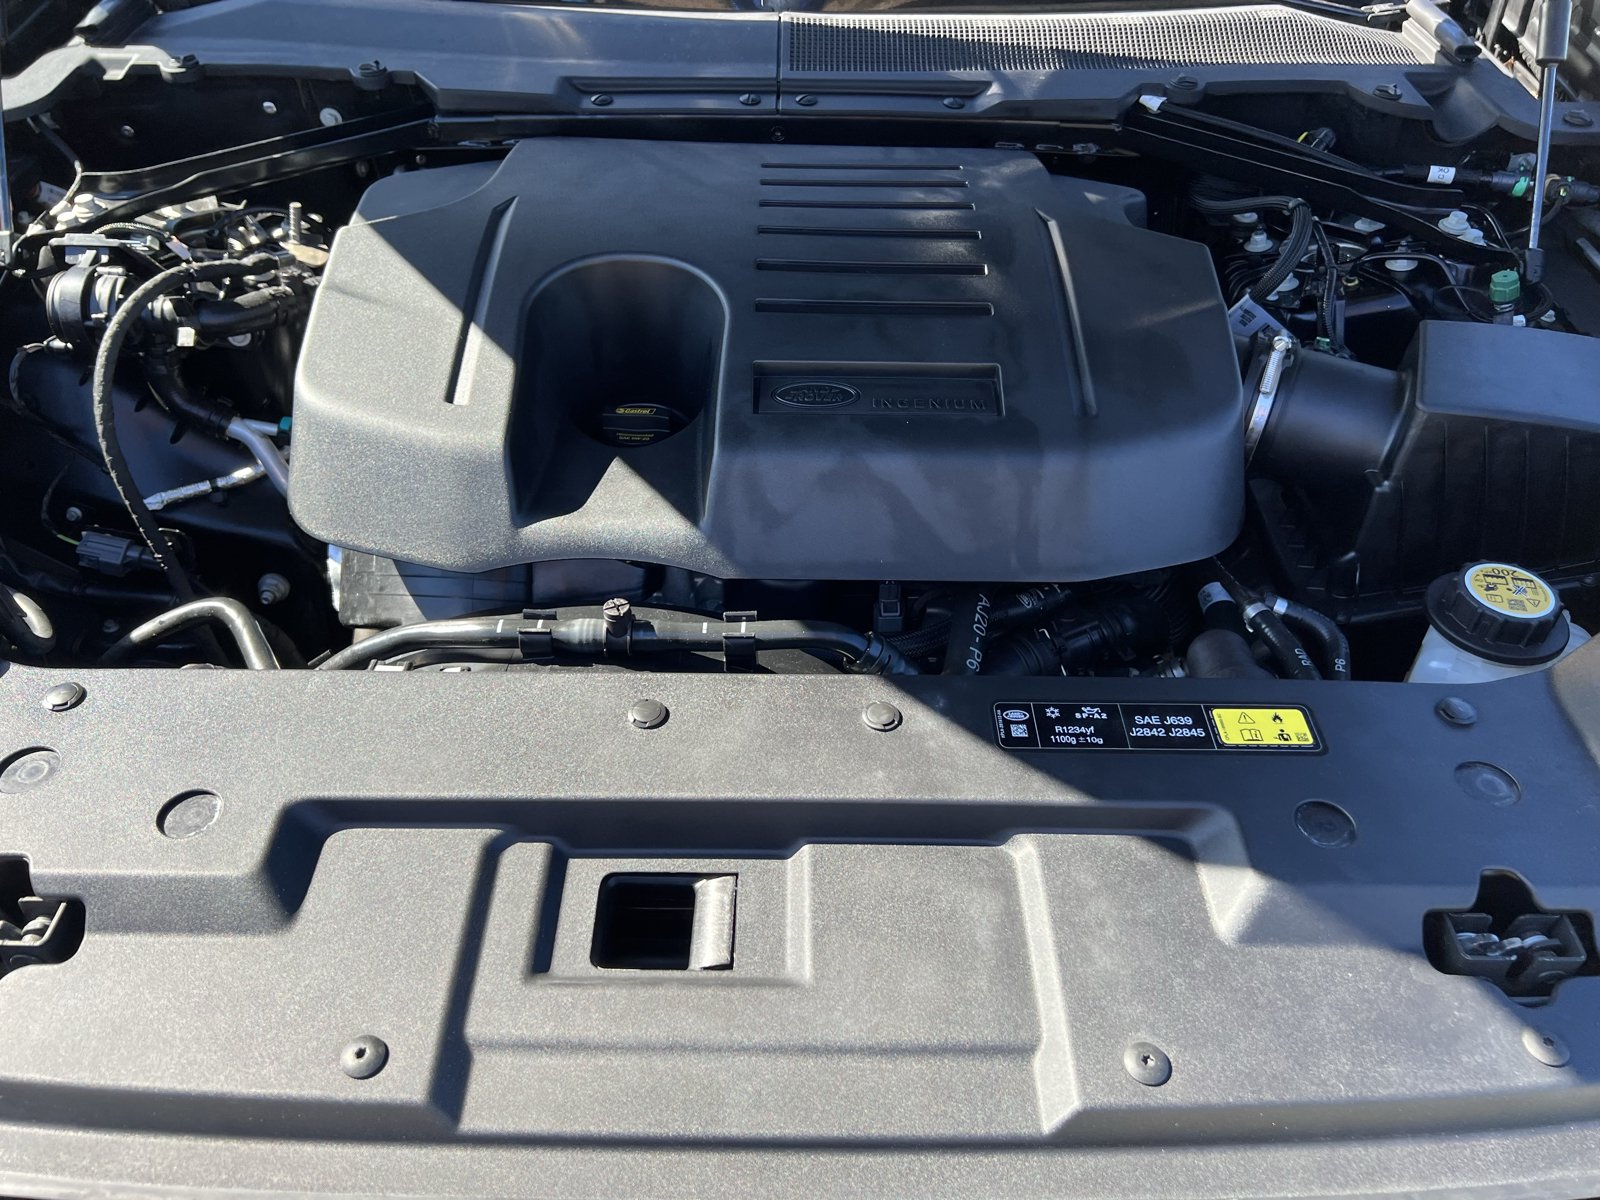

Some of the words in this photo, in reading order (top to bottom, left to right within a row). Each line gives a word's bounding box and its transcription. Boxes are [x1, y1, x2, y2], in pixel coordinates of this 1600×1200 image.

[872, 397, 986, 410] INGENIUM
[1334, 658, 1346, 672] P6
[1134, 716, 1162, 725] SAE
[1163, 716, 1193, 725] J639
[1055, 725, 1095, 735] R1234yf
[1129, 727, 1166, 737] J2842
[1168, 728, 1206, 737] J2845
[1050, 735, 1076, 744] 1100g
[1078, 736, 1104, 744] ±10g
